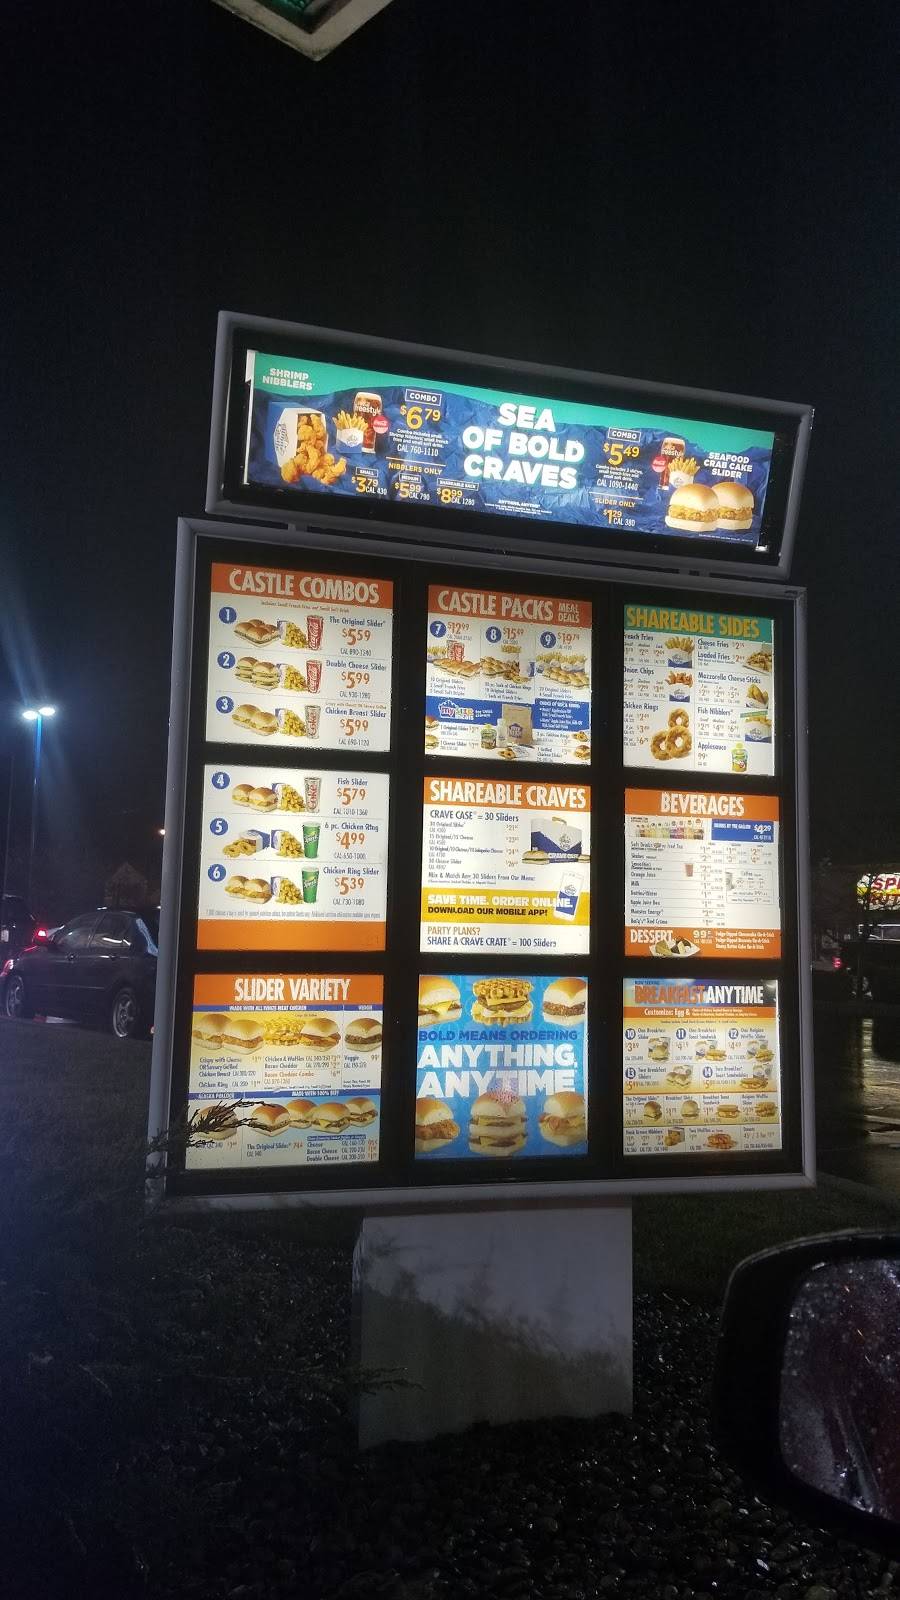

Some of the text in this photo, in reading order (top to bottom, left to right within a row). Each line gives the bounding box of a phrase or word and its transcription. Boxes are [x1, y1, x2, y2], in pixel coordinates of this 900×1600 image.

[270, 368, 309, 380] SHRIMP
[262, 376, 313, 390] NIBBLERS
[410, 392, 438, 402] COMBO
[498, 402, 556, 432] SEA
[612, 430, 637, 440] COMBO
[462, 426, 504, 452] OF
[508, 432, 585, 462] BOLD
[397, 444, 439, 456] CAL 760-1110
[708, 452, 750, 464] SEAFOOD
[388, 462, 422, 472] NIBBLERS
[704, 459, 752, 472] CRAB CAKE
[463, 454, 578, 490] CRAVES
[712, 468, 742, 479] SLIDER
[596, 479, 607, 487] CAL
[366, 486, 376, 494] CAL
[409, 492, 419, 500] CAL
[595, 497, 617, 505] SLIDER
[614, 517, 624, 526] CAL
[229, 569, 380, 604] CASTLE COMBOS
[438, 590, 554, 622] CASTLE PACKS
[559, 602, 579, 613] MEAL
[330, 616, 365, 626] The Original
[558, 612, 580, 623] DEALS
[626, 607, 761, 640] SHAREABLE SIDES
[435, 624, 440, 635] 7
[490, 629, 496, 639] 8
[545, 635, 551, 645] 9
[698, 639, 729, 648] Cheese Fries
[223, 654, 230, 666] 2
[326, 660, 346, 668] Double
[370, 663, 386, 671] Slider
[698, 672, 726, 681] Mozzarella
[746, 676, 761, 684] Sticks
[221, 698, 229, 710] 3
[644, 703, 659, 712] Rings
[325, 707, 348, 715] Chicken
[370, 710, 387, 718] Slider
[698, 741, 726, 751] Applesauce
[217, 775, 224, 786] 4
[337, 788, 366, 806] $579
[430, 780, 586, 809] SHAREABLE CRAVES
[660, 792, 745, 816] BEVERAGES
[430, 810, 453, 819] CRAVE
[456, 812, 473, 820] CASE
[485, 812, 493, 820] 30
[496, 813, 519, 821] Sliders
[216, 821, 223, 832] 5
[342, 822, 364, 830] Chicken
[365, 824, 379, 832] Ring
[336, 832, 365, 849] $499
[213, 867, 220, 878] 6
[323, 866, 345, 874] Chicken
[348, 867, 361, 876] Ring
[335, 877, 364, 895] $539
[873, 878, 900, 890] SP
[428, 895, 457, 905] SAVE
[459, 896, 488, 906] TIME.
[492, 896, 530, 906] ORDER
[427, 926, 481, 936] PARTY PLANS?
[630, 929, 673, 944] DESSERT
[427, 936, 451, 946] SHARE
[453, 937, 459, 945] A
[461, 937, 483, 946] CRAVE
[486, 938, 507, 946] CRATE
[519, 939, 532, 947] 100
[533, 939, 556, 948] Sliders
[234, 978, 351, 1001] SLIDER VARIETY
[635, 985, 763, 1004] BREAKFAST ANYTIME
[675, 1008, 685, 1017] Egg
[419, 1030, 578, 1041] BOLD MEANS ORDERING
[417, 1043, 578, 1069] ANYTHING,
[416, 1070, 576, 1098] ANYTIME
